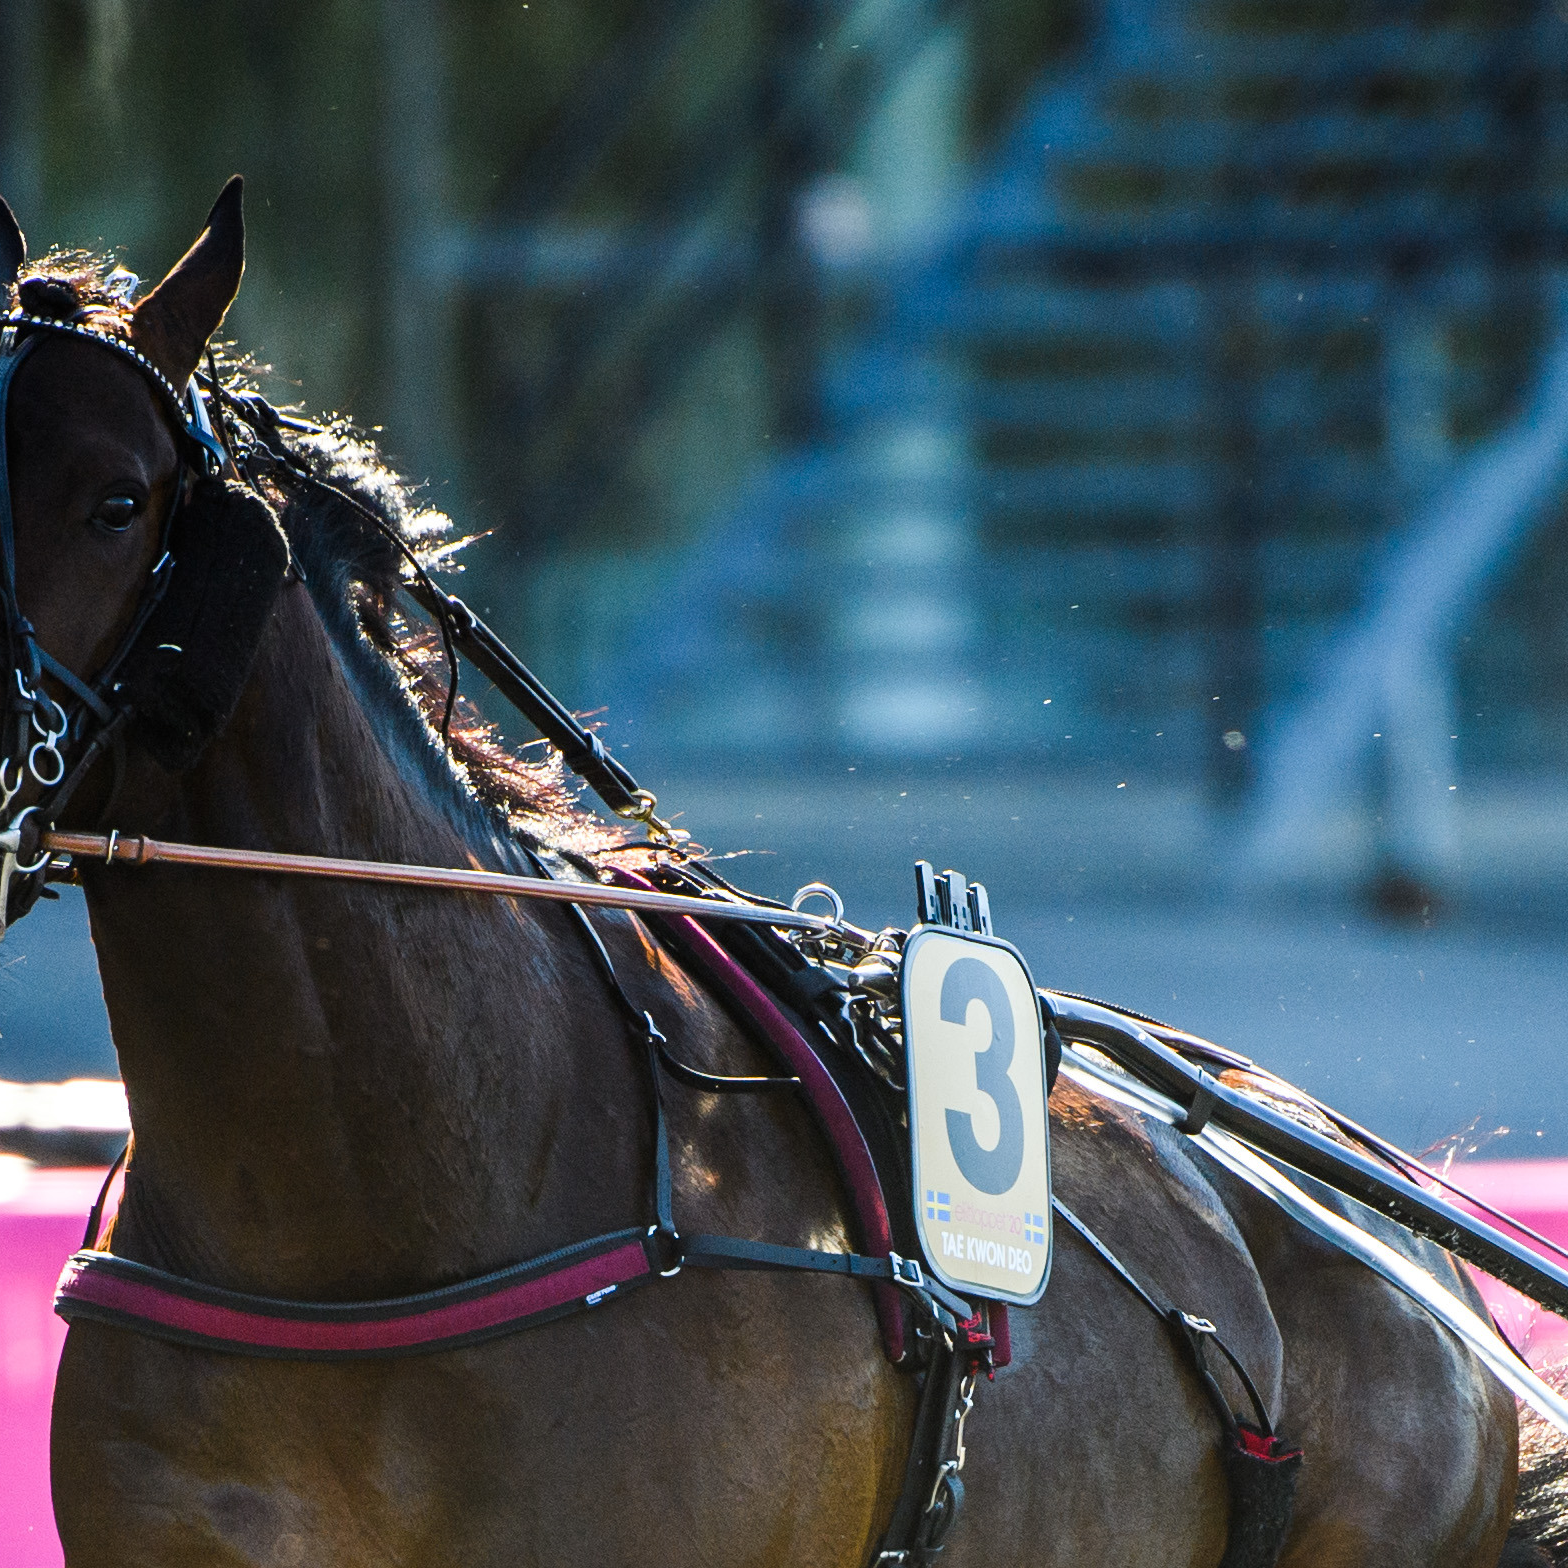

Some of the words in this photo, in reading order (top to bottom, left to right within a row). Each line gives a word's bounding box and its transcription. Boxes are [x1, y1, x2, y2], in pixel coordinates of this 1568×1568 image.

[940, 957, 1025, 1196] 3
[941, 1231, 965, 1259] TAE
[966, 1236, 1007, 1269] KWON
[1008, 1246, 1033, 1275] DEO
